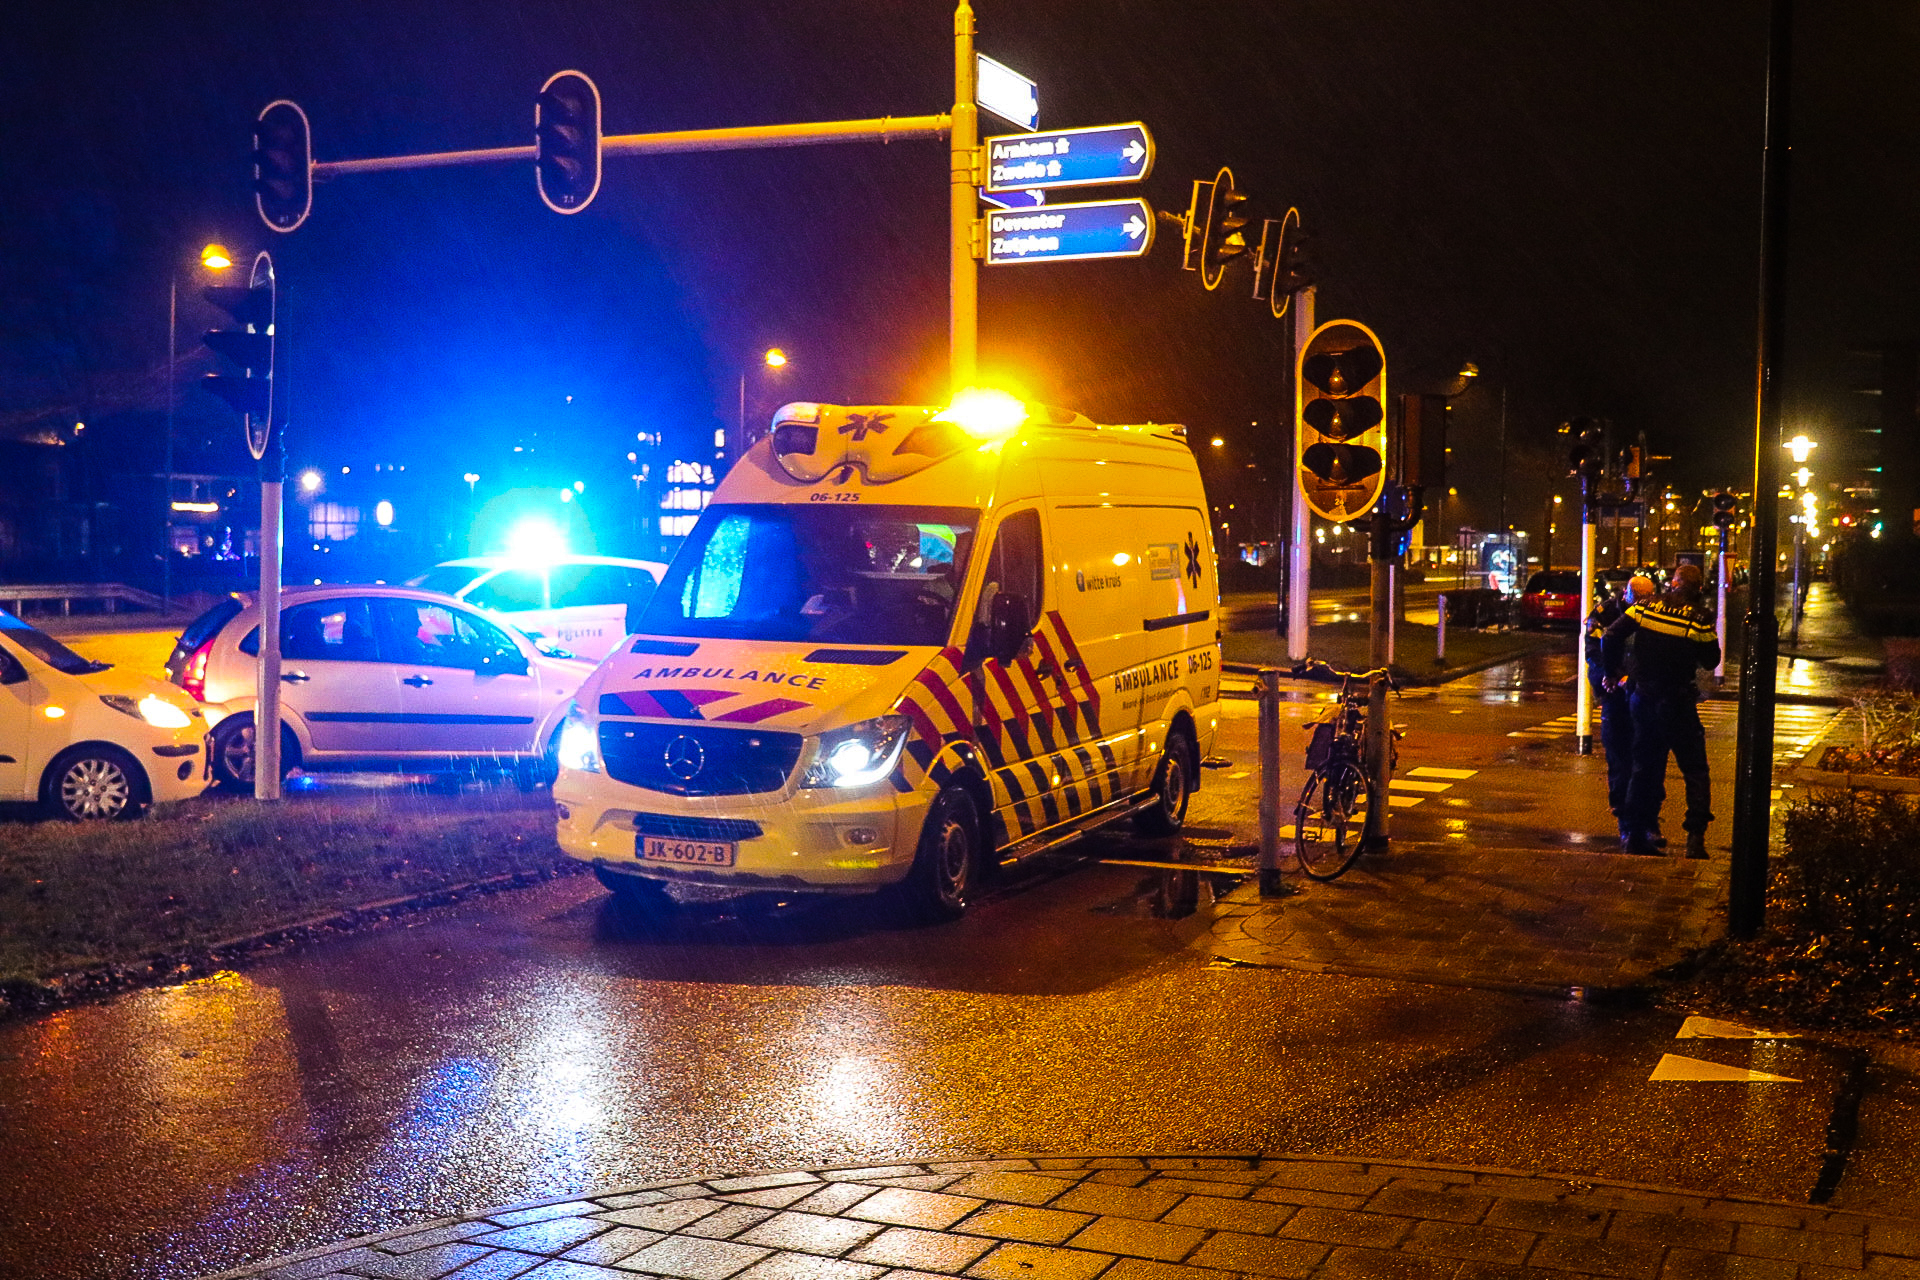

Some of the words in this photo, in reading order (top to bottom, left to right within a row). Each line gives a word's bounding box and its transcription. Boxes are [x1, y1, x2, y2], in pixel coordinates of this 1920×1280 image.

[993, 142, 1054, 159] Arnhem
[993, 162, 1046, 181] Zwolle
[993, 214, 1065, 232] Deventer
[993, 235, 1060, 256] Zutphen
[810, 493, 861, 502] 06-125
[557, 628, 604, 642] POLITIE
[1187, 651, 1212, 674] 06-125
[633, 667, 827, 690] AMBULANCE
[1115, 659, 1179, 694] AMBULANCE
[648, 841, 725, 862] JK-602-B
